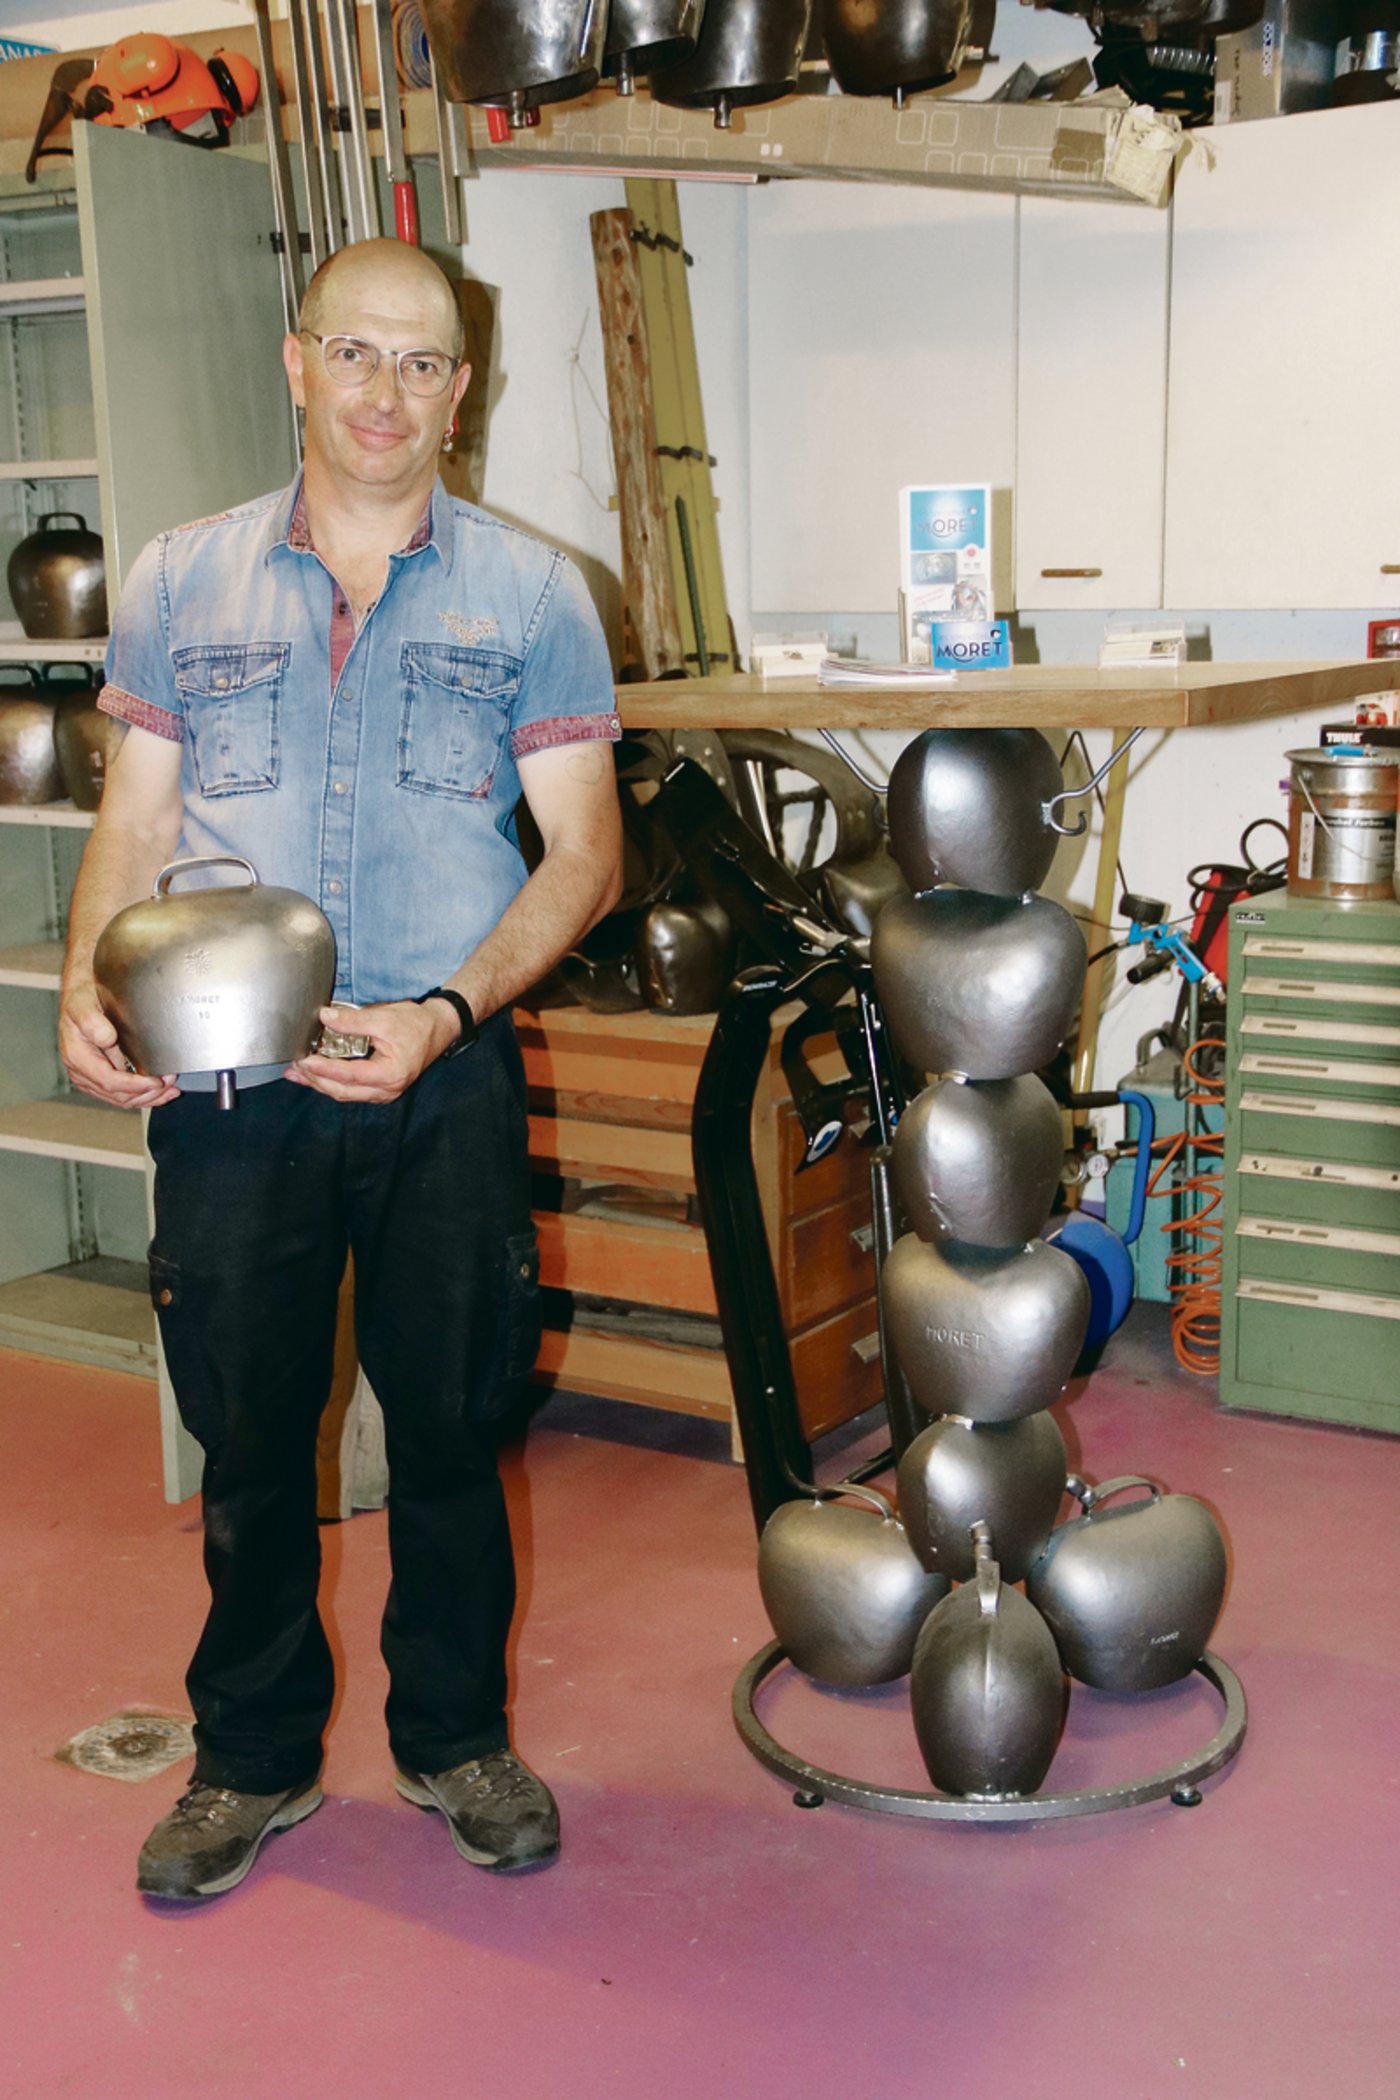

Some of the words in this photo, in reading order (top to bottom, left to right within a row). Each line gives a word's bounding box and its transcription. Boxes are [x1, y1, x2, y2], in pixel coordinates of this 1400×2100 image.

[936, 641, 1002, 660] MORET
[1326, 731, 1364, 744] THULE
[925, 1325, 985, 1350] MORET
